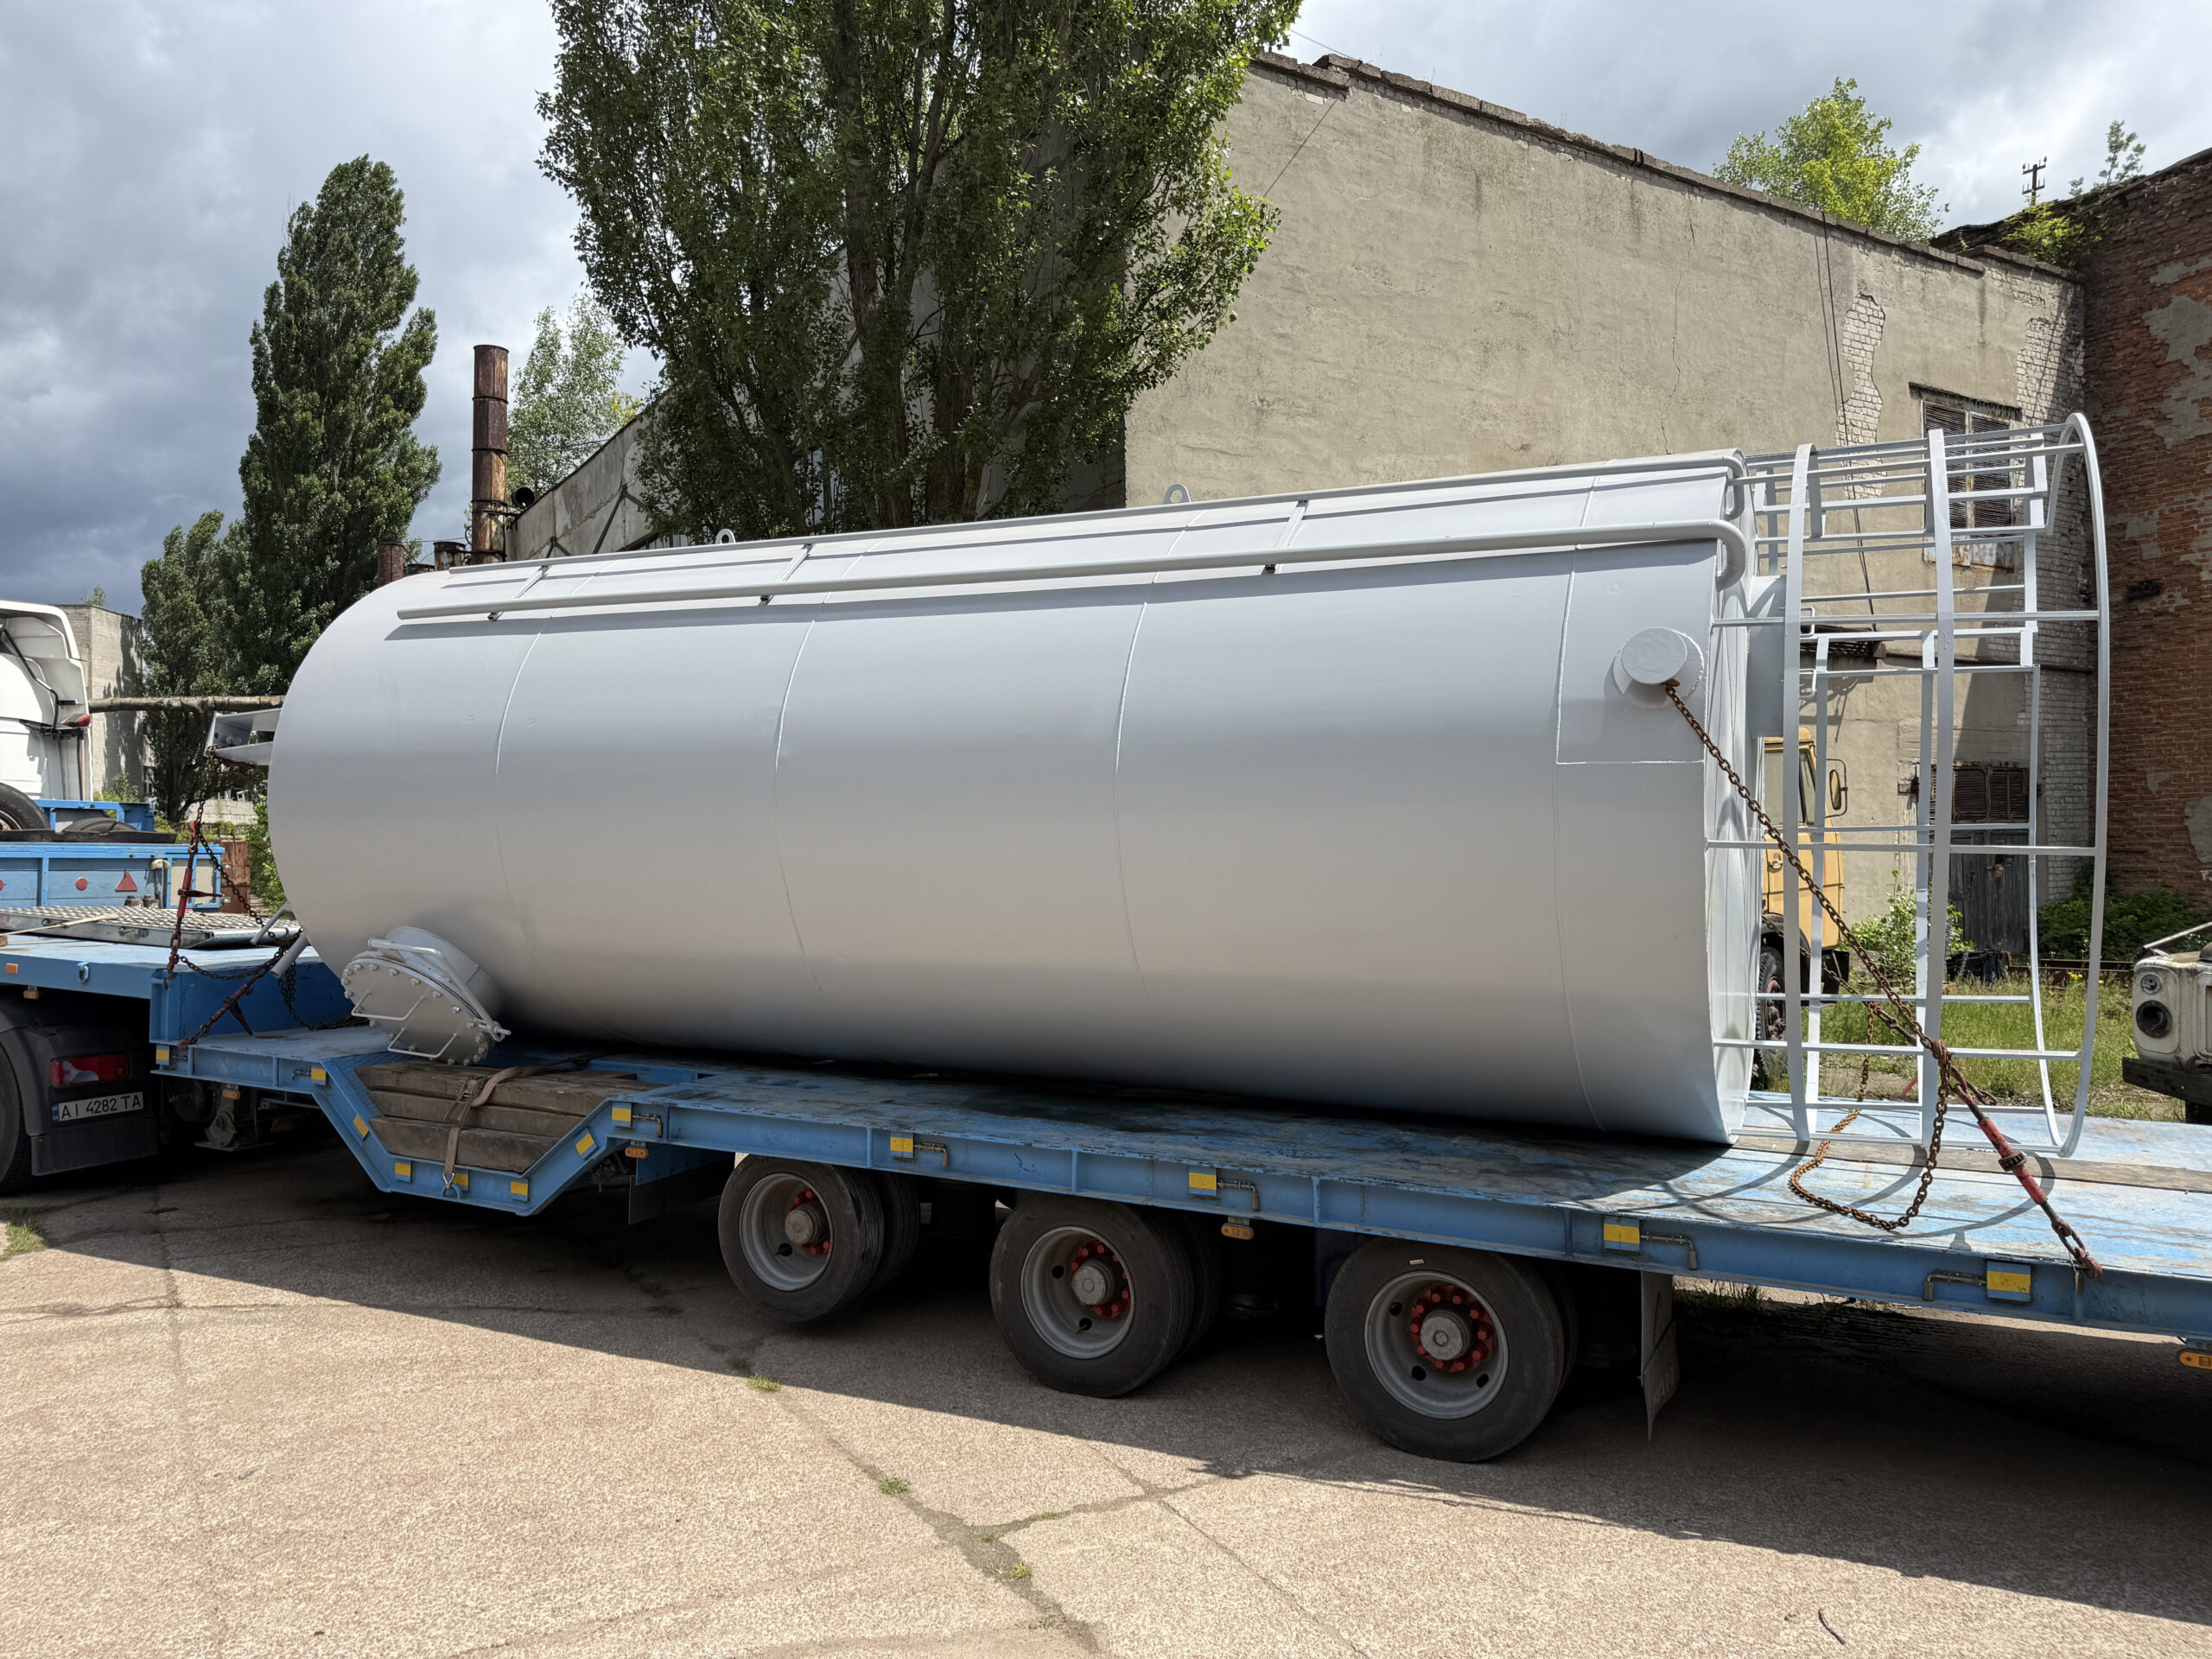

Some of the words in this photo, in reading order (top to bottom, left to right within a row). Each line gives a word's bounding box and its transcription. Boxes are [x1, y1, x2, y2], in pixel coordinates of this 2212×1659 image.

[61, 1103, 78, 1119] AI
[86, 1098, 117, 1115] 4282
[121, 1095, 142, 1109] TA
